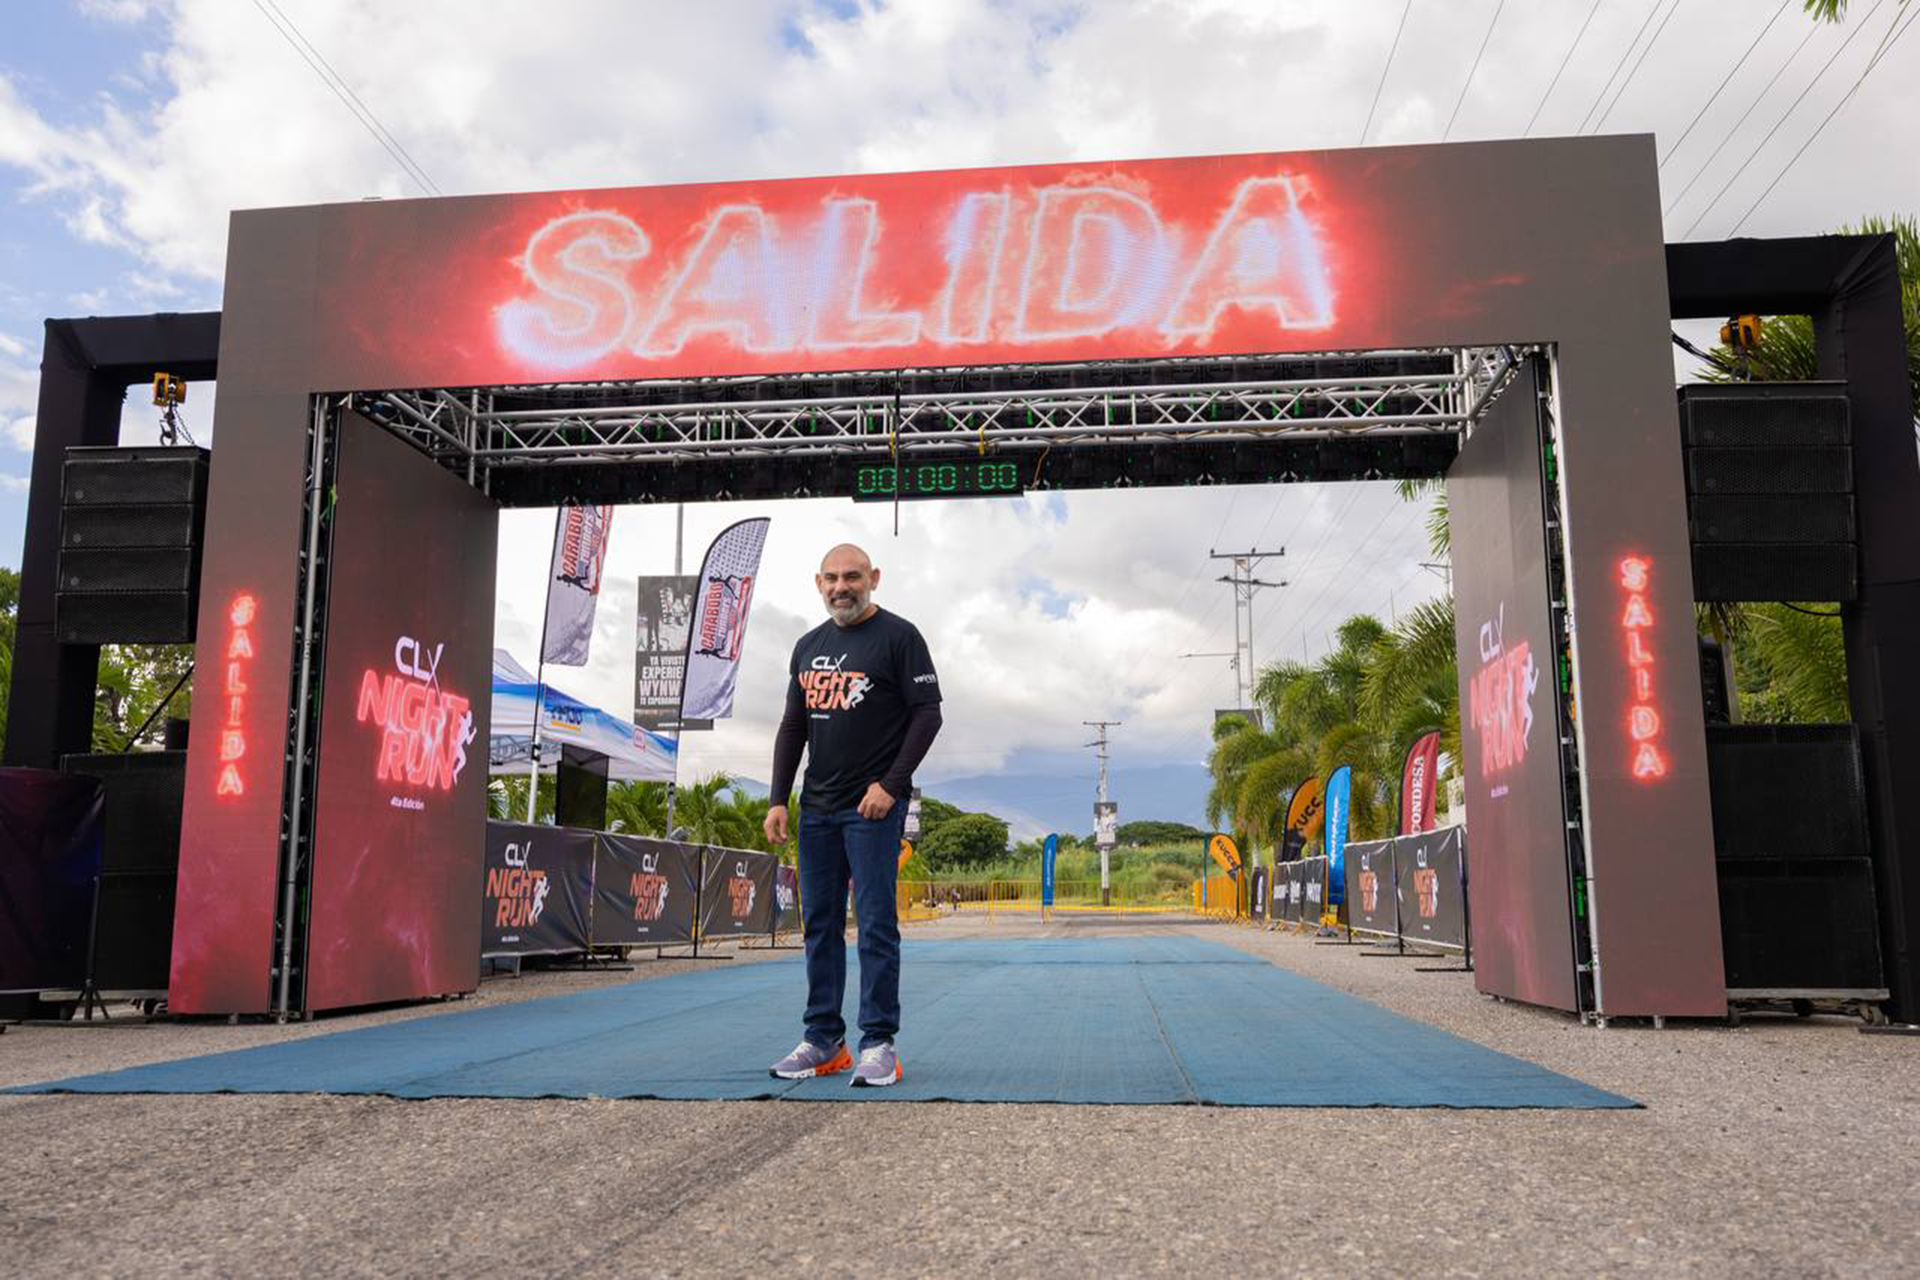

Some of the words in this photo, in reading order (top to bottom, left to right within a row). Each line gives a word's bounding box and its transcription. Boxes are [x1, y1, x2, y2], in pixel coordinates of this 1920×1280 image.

[498, 172, 1336, 368] SALIDA
[858, 464, 1017, 493] 00:00:00
[562, 505, 584, 577] CARABOB
[700, 582, 724, 649] CARABOBO
[395, 636, 444, 688] CLX
[642, 666, 684, 679] EXPERIE
[798, 671, 865, 691] NIGHT
[811, 653, 848, 673] CLX
[1620, 557, 1666, 777] SALIDA
[216, 596, 256, 795] SALIDA
[357, 669, 469, 741] NIGHT
[639, 680, 682, 697] WYNW
[805, 689, 851, 711] RUN
[377, 729, 456, 790] RUN
[1410, 756, 1425, 836] CONDESA
[505, 841, 532, 868] CLX
[486, 868, 546, 898] NIGHT
[495, 898, 535, 927] RUN
